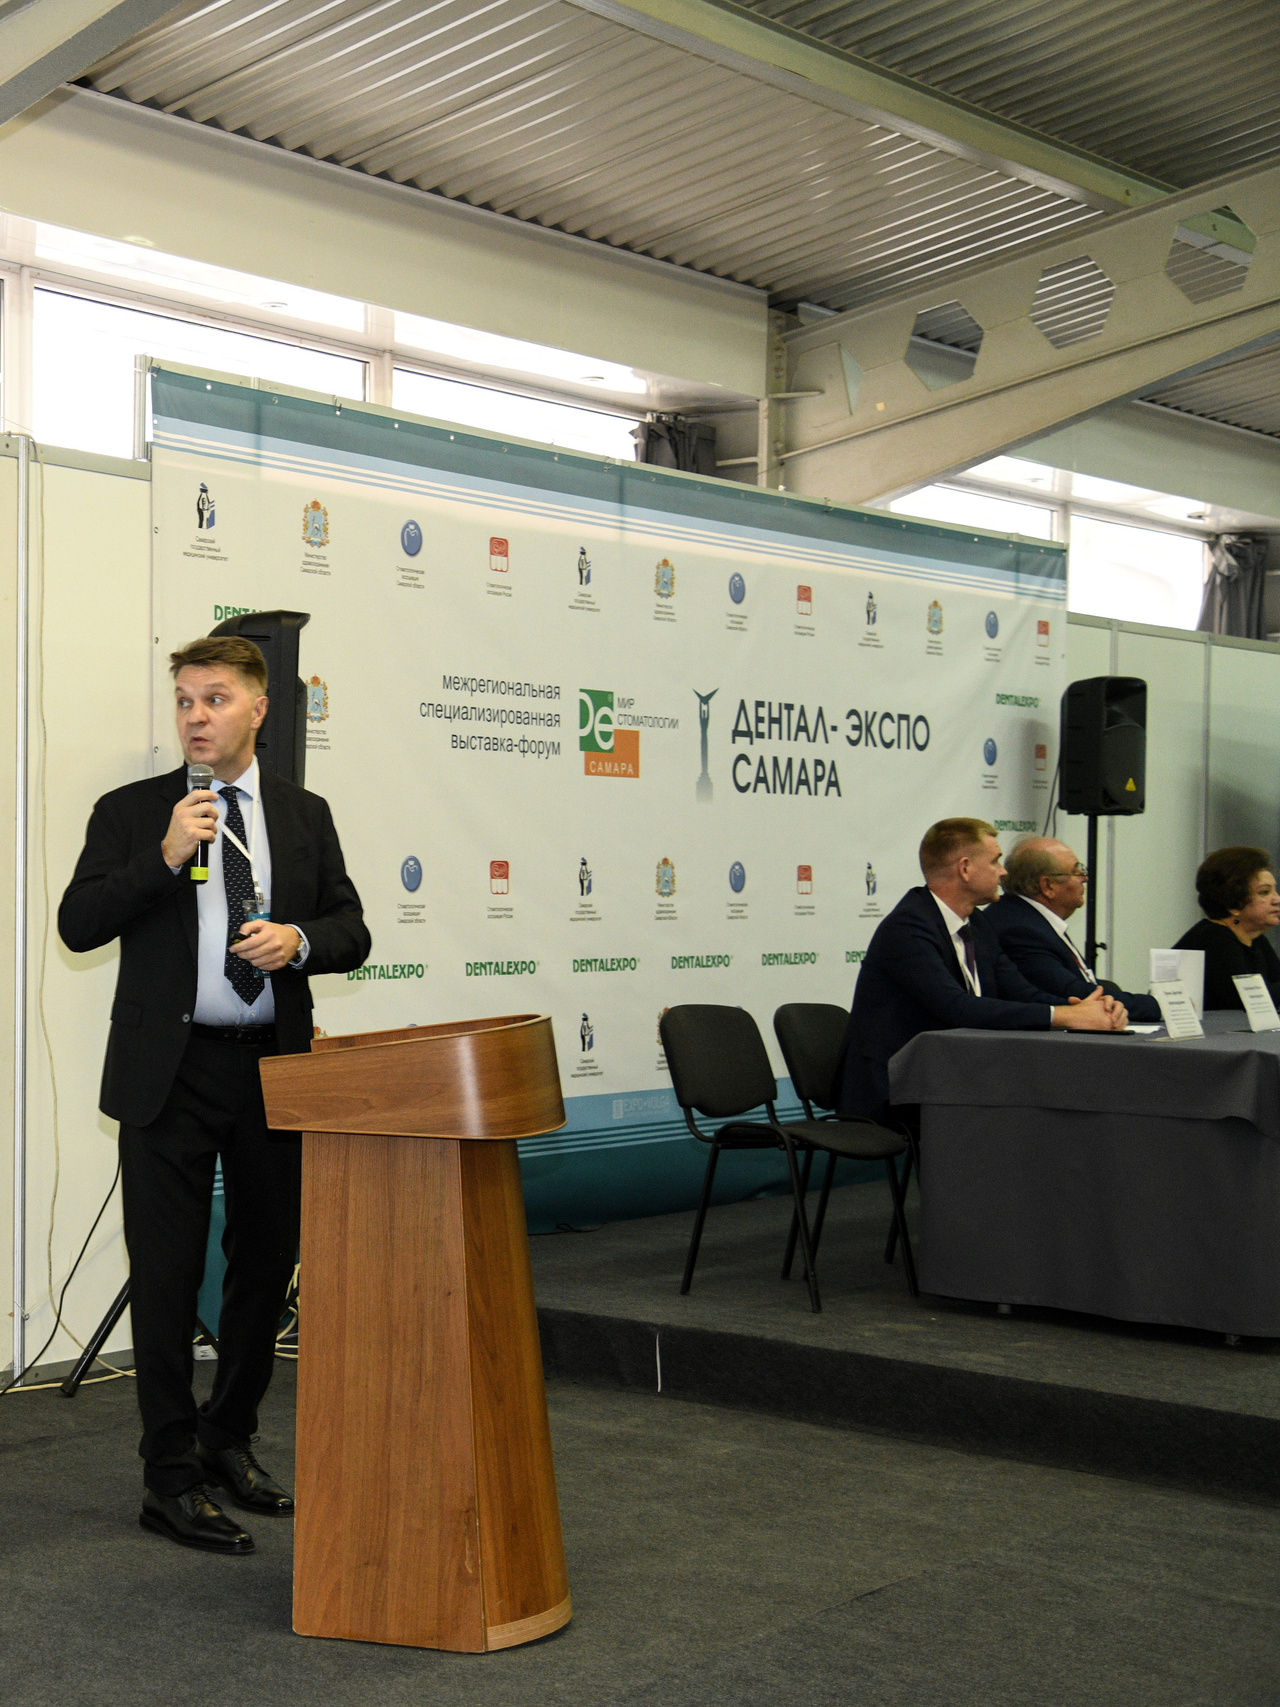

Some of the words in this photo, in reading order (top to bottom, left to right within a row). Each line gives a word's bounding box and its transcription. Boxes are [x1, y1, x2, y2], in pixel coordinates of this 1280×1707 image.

[442, 674, 561, 700] межрегиональная
[617, 697, 635, 710] МИР
[419, 702, 561, 728] специализированная
[617, 713, 679, 729] СТОМАТОЛОГИИ
[845, 708, 930, 751] ЭКСПО
[451, 734, 561, 760] выставка-форум
[589, 760, 634, 775] САМАРА
[732, 753, 842, 797] САМАРА
[572, 957, 637, 973] DENTALEXPO
[671, 954, 731, 969] DENTALEXPO
[761, 951, 817, 966] DENTALEXPO
[347, 963, 425, 981] DENTALEXPO
[465, 960, 537, 977] DENTALEXPO
